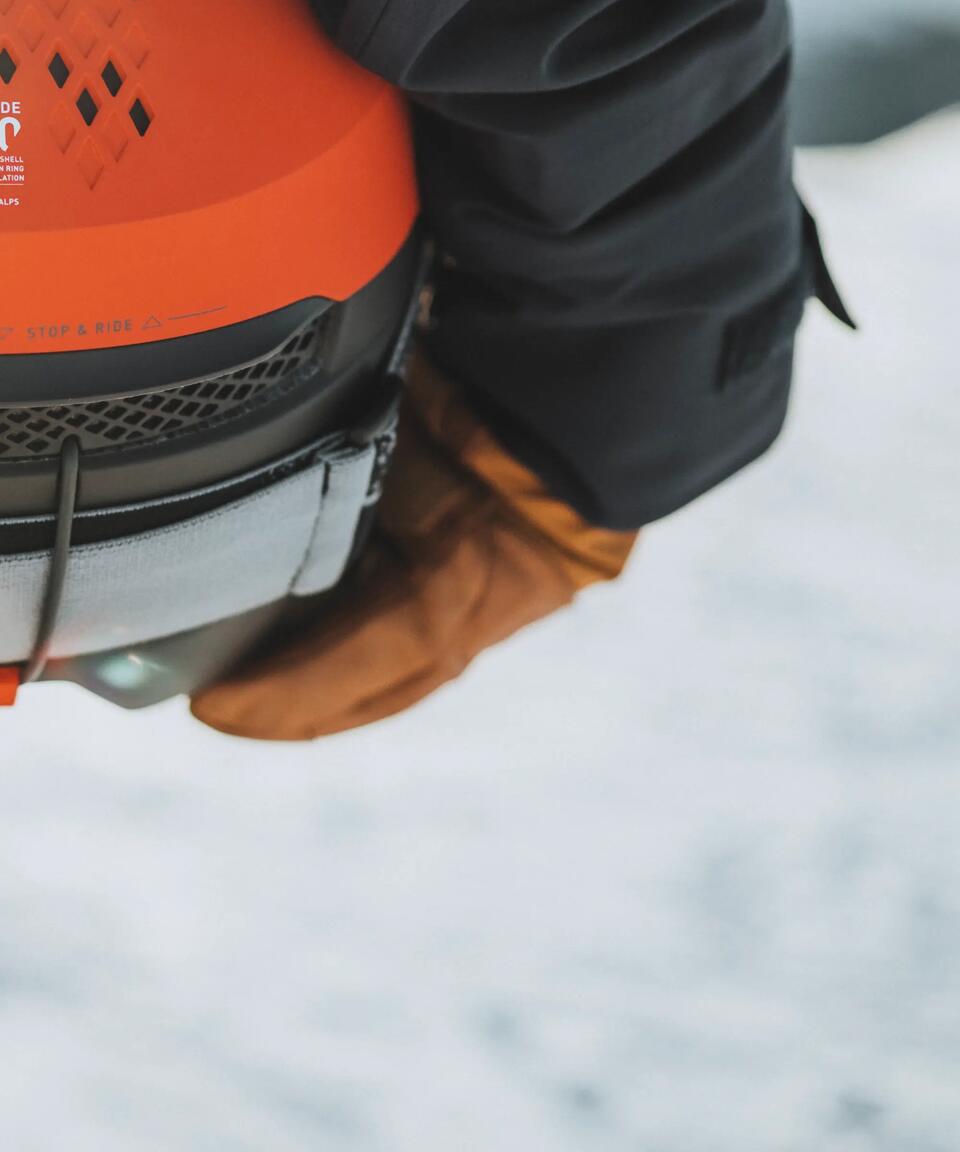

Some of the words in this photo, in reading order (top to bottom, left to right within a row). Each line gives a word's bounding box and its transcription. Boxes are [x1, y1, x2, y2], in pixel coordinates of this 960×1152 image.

[0, 155, 24, 163] SHELL
[26, 324, 71, 340] STOP
[76, 323, 88, 337] &
[94, 318, 134, 335] RIDE
